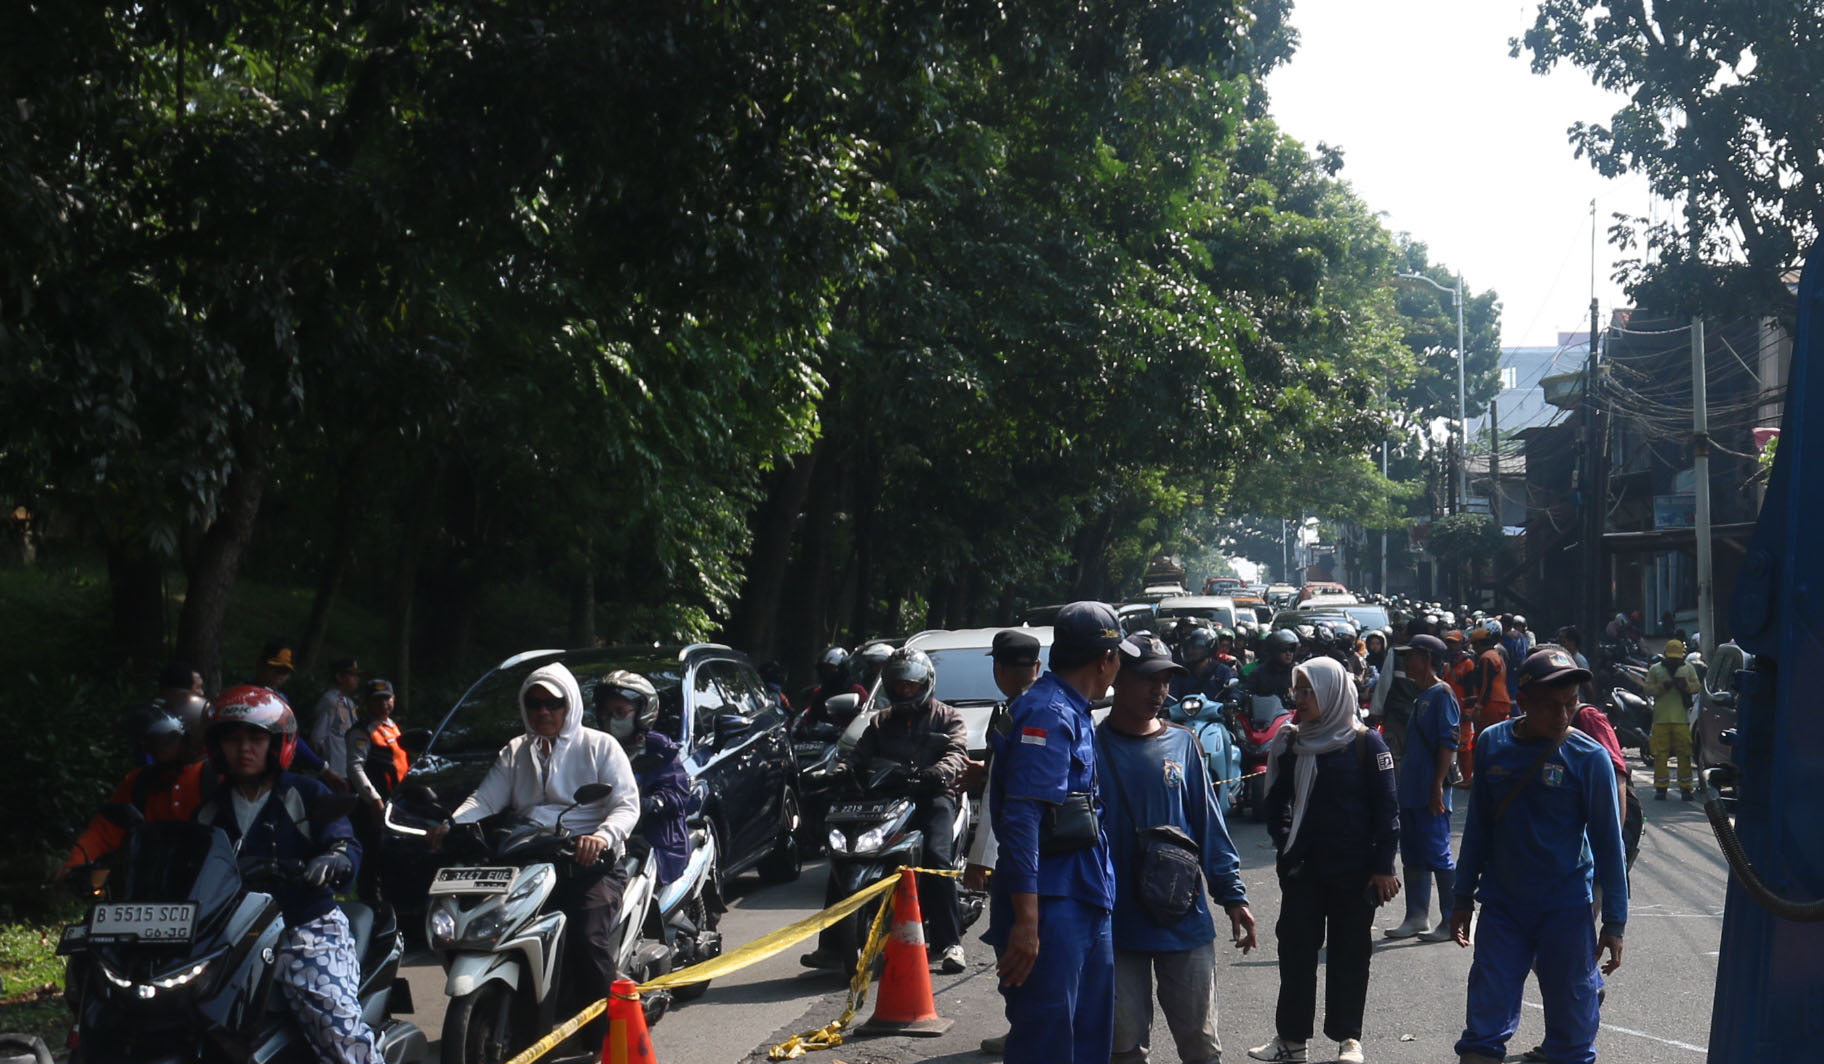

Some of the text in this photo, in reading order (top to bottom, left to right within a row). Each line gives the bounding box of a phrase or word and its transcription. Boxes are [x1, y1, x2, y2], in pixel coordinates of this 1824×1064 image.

[97, 906, 190, 923] B 5515 SCD
